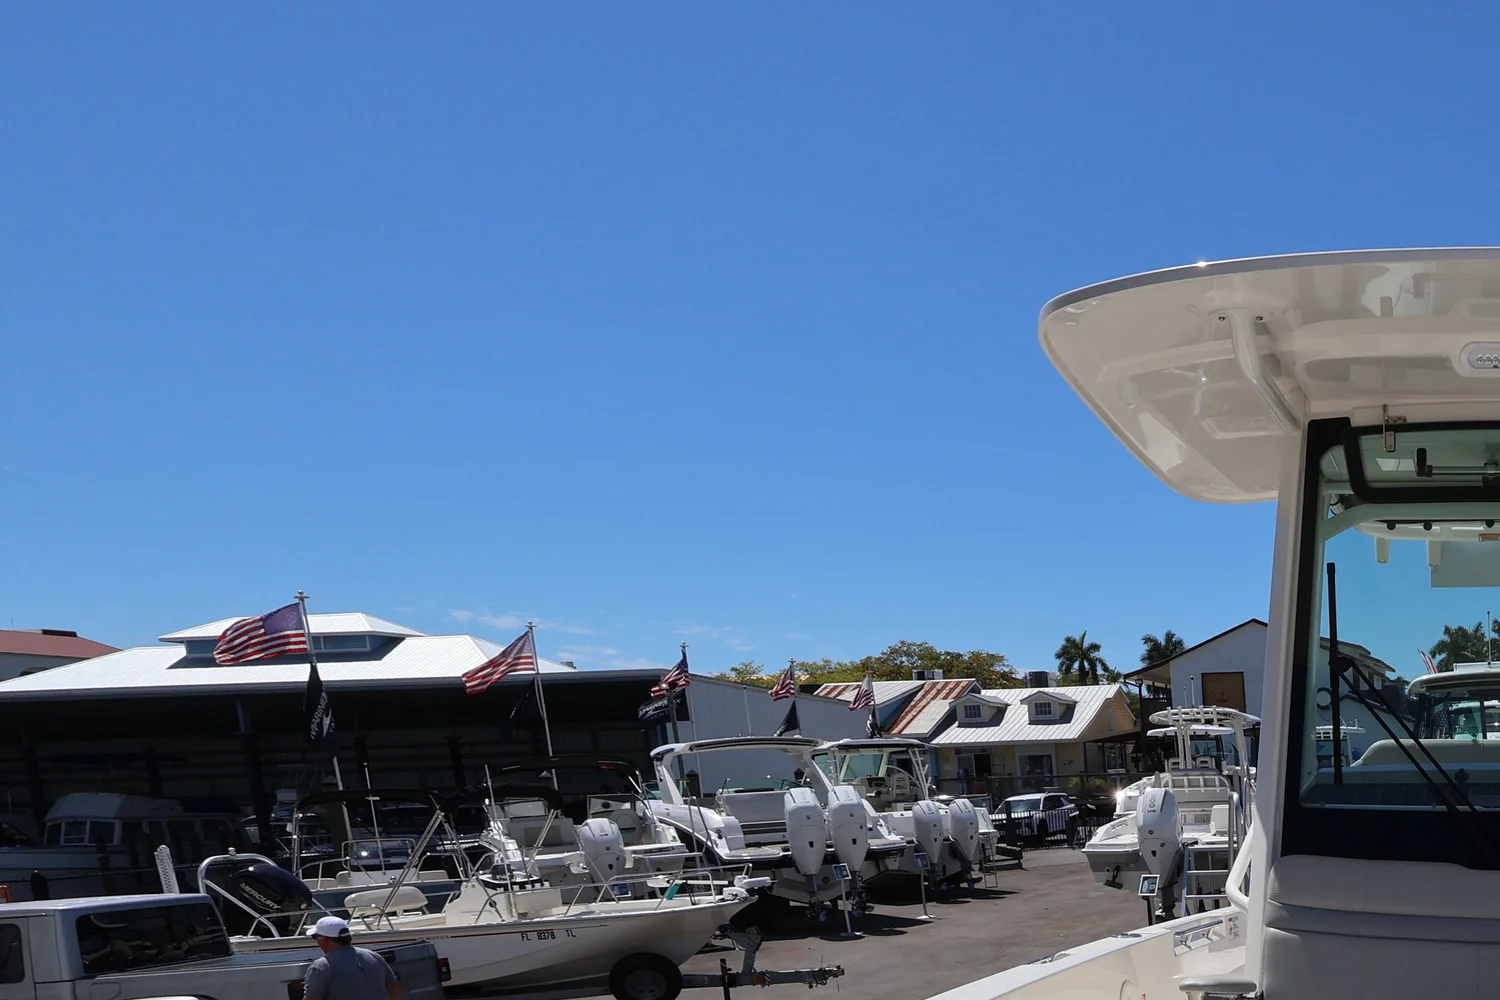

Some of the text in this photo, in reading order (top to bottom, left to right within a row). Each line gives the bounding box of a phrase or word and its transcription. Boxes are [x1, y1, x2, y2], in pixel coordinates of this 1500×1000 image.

[240, 883, 281, 909] MERCURY
[521, 932, 531, 941] FL
[565, 929, 576, 938] TL
